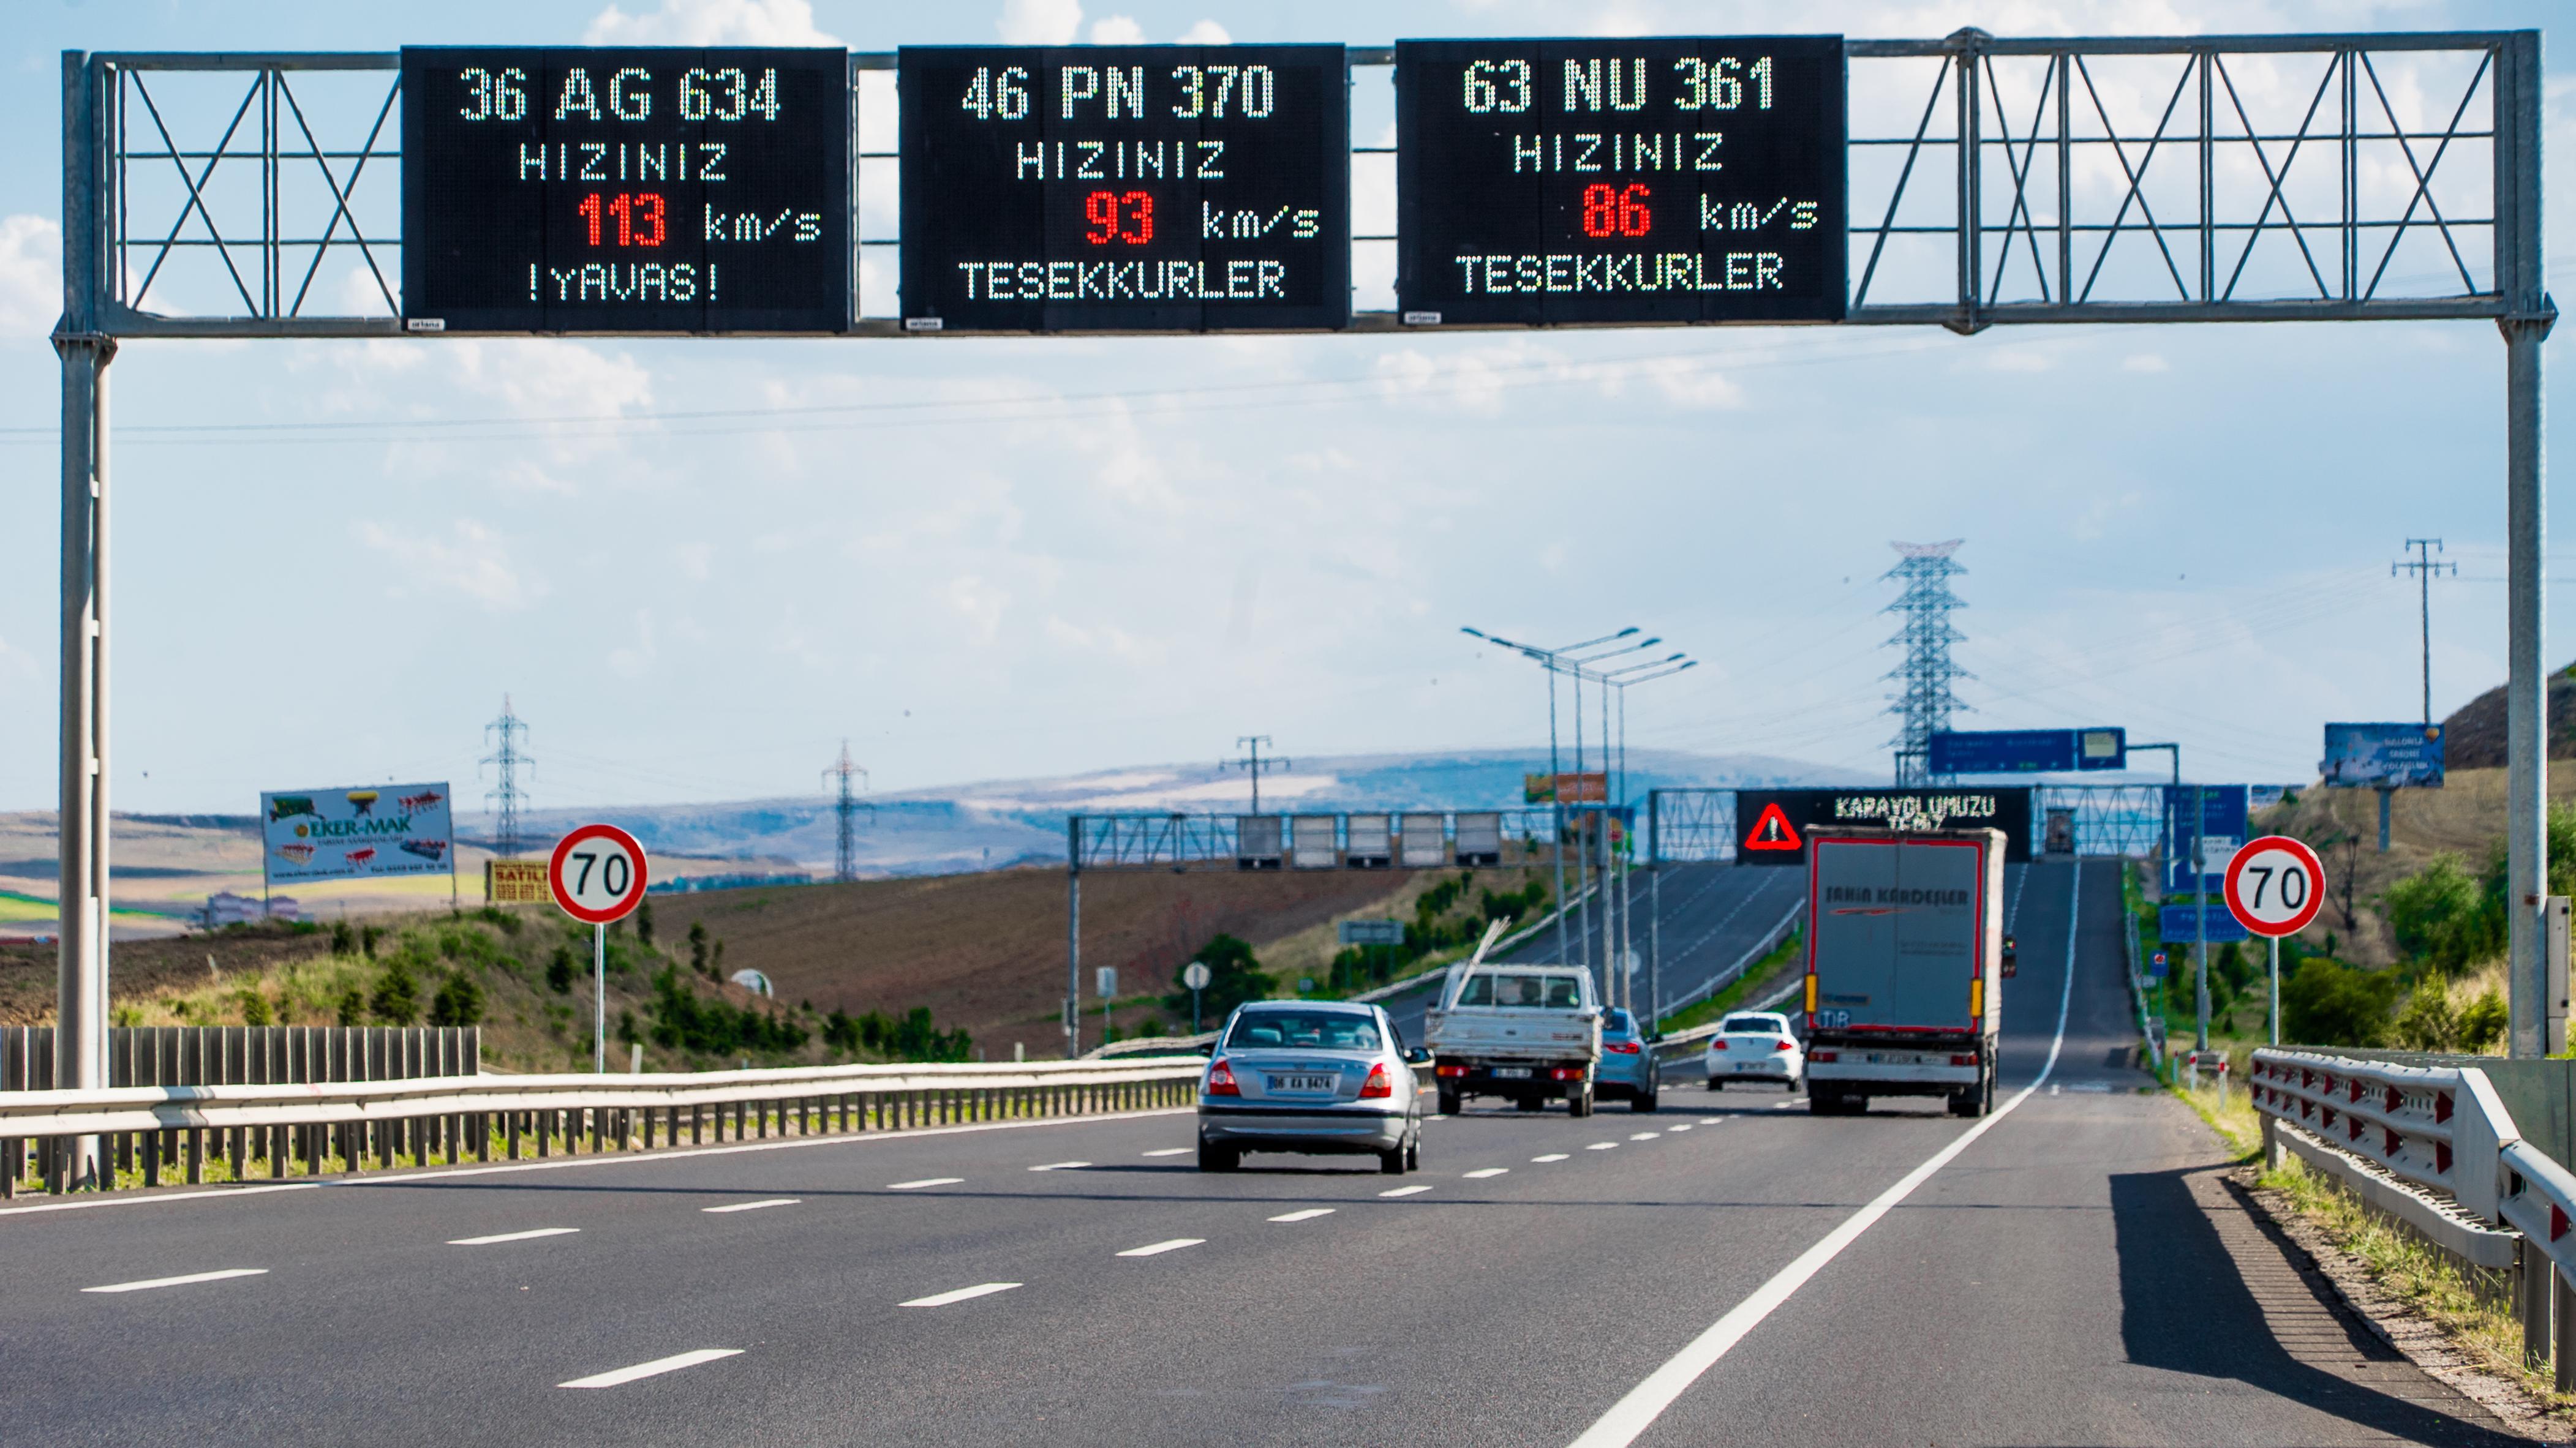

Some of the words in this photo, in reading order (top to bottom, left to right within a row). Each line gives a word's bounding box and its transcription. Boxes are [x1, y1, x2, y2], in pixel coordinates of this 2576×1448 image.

[461, 68, 526, 121] 36
[555, 68, 651, 121] AG
[680, 68, 780, 121] 634
[962, 67, 1029, 119] 46
[1062, 66, 1143, 119] PN
[1172, 66, 1273, 118] 370
[1464, 59, 1531, 113] 63
[1565, 58, 1646, 111] NU
[1674, 56, 1772, 110] 361
[521, 143, 726, 181] HIZINIZ
[1018, 141, 1224, 179] HIZINIZ
[1515, 133, 1722, 173] HIZINIZ
[579, 193, 665, 246] 113
[706, 203, 821, 241] km/s
[1086, 191, 1153, 244] 93
[1203, 201, 1319, 239] km/s
[1584, 184, 1651, 237] 86
[1701, 193, 1817, 230] km/s
[530, 263, 716, 301] !YAVAS!
[958, 260, 1284, 299] TESEKKURLER
[1455, 252, 1783, 293] TESEKKURLER
[310, 816, 411, 837] EKER-MAK
[1836, 795, 1996, 818] KARAYOLUMUZU
[495, 871, 548, 882] SATILI
[571, 852, 629, 897] 70
[2249, 866, 2306, 909] 70
